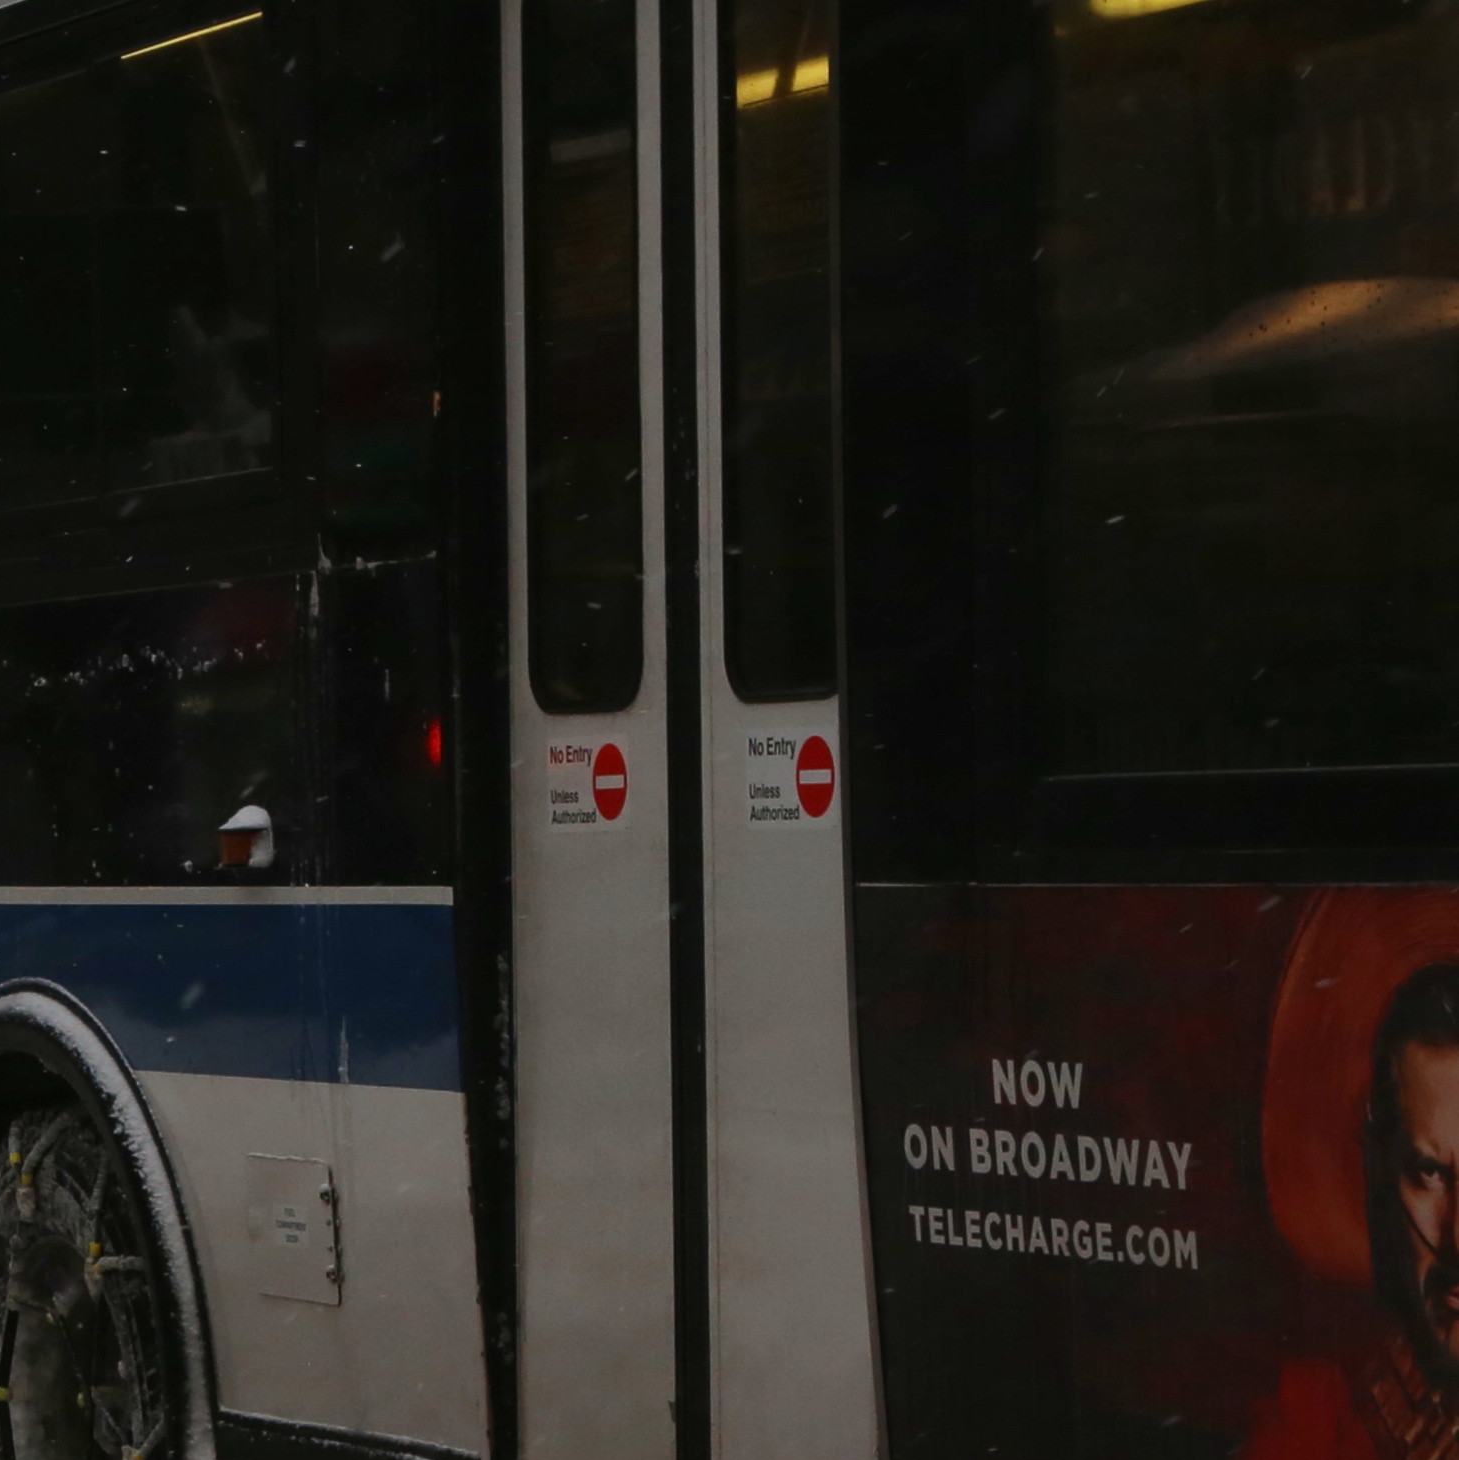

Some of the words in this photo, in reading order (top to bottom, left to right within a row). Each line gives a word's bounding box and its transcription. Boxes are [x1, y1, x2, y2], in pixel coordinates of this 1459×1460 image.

[550, 746, 564, 764] No
[566, 745, 592, 767] Entry
[749, 738, 765, 756] No
[767, 737, 796, 760] Entry
[550, 789, 579, 804] Unless
[749, 783, 781, 799] Unless
[551, 808, 597, 824] Authorized
[750, 805, 800, 822] Authorized
[992, 1058, 1083, 1109] NOW
[904, 1123, 955, 1171] ON
[969, 1128, 1192, 1190] BROADWAY
[909, 1205, 1198, 1269] TELECHARGE.COM
